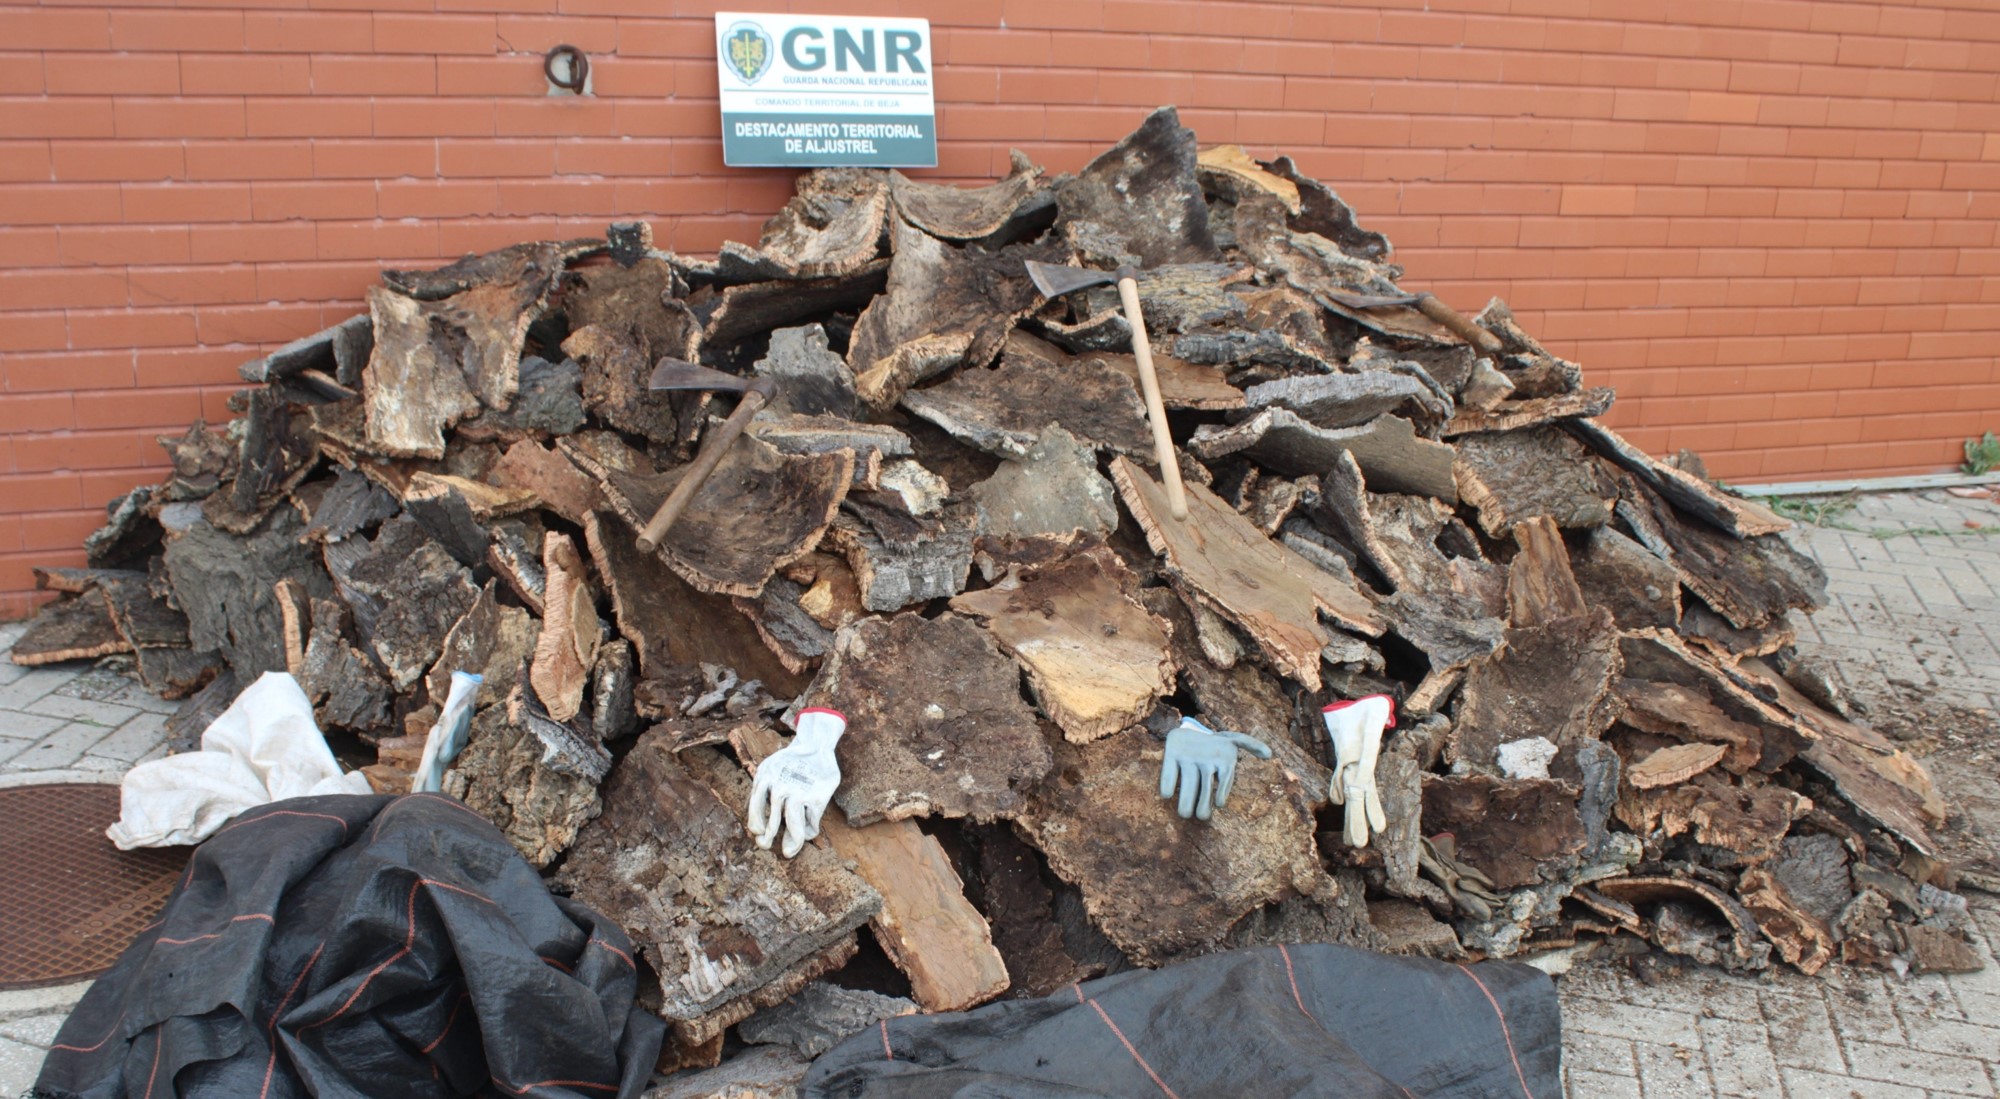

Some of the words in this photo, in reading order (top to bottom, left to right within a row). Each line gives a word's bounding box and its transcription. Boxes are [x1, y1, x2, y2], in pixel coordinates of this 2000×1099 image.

[781, 26, 926, 73] GNR
[783, 76, 819, 85] GUARDA
[822, 77, 866, 86] NACIONAL
[868, 77, 928, 87] REPUBLICANA
[755, 98, 801, 106] COMANDO
[804, 98, 861, 107] TERRITORIAL
[863, 99, 876, 107] DE
[878, 100, 900, 108] BEJA
[735, 122, 839, 137] DESTACAMENTO
[842, 124, 922, 139] TERRITORIAL
[785, 139, 803, 153] DE
[805, 139, 877, 154] ALJUSTREL
